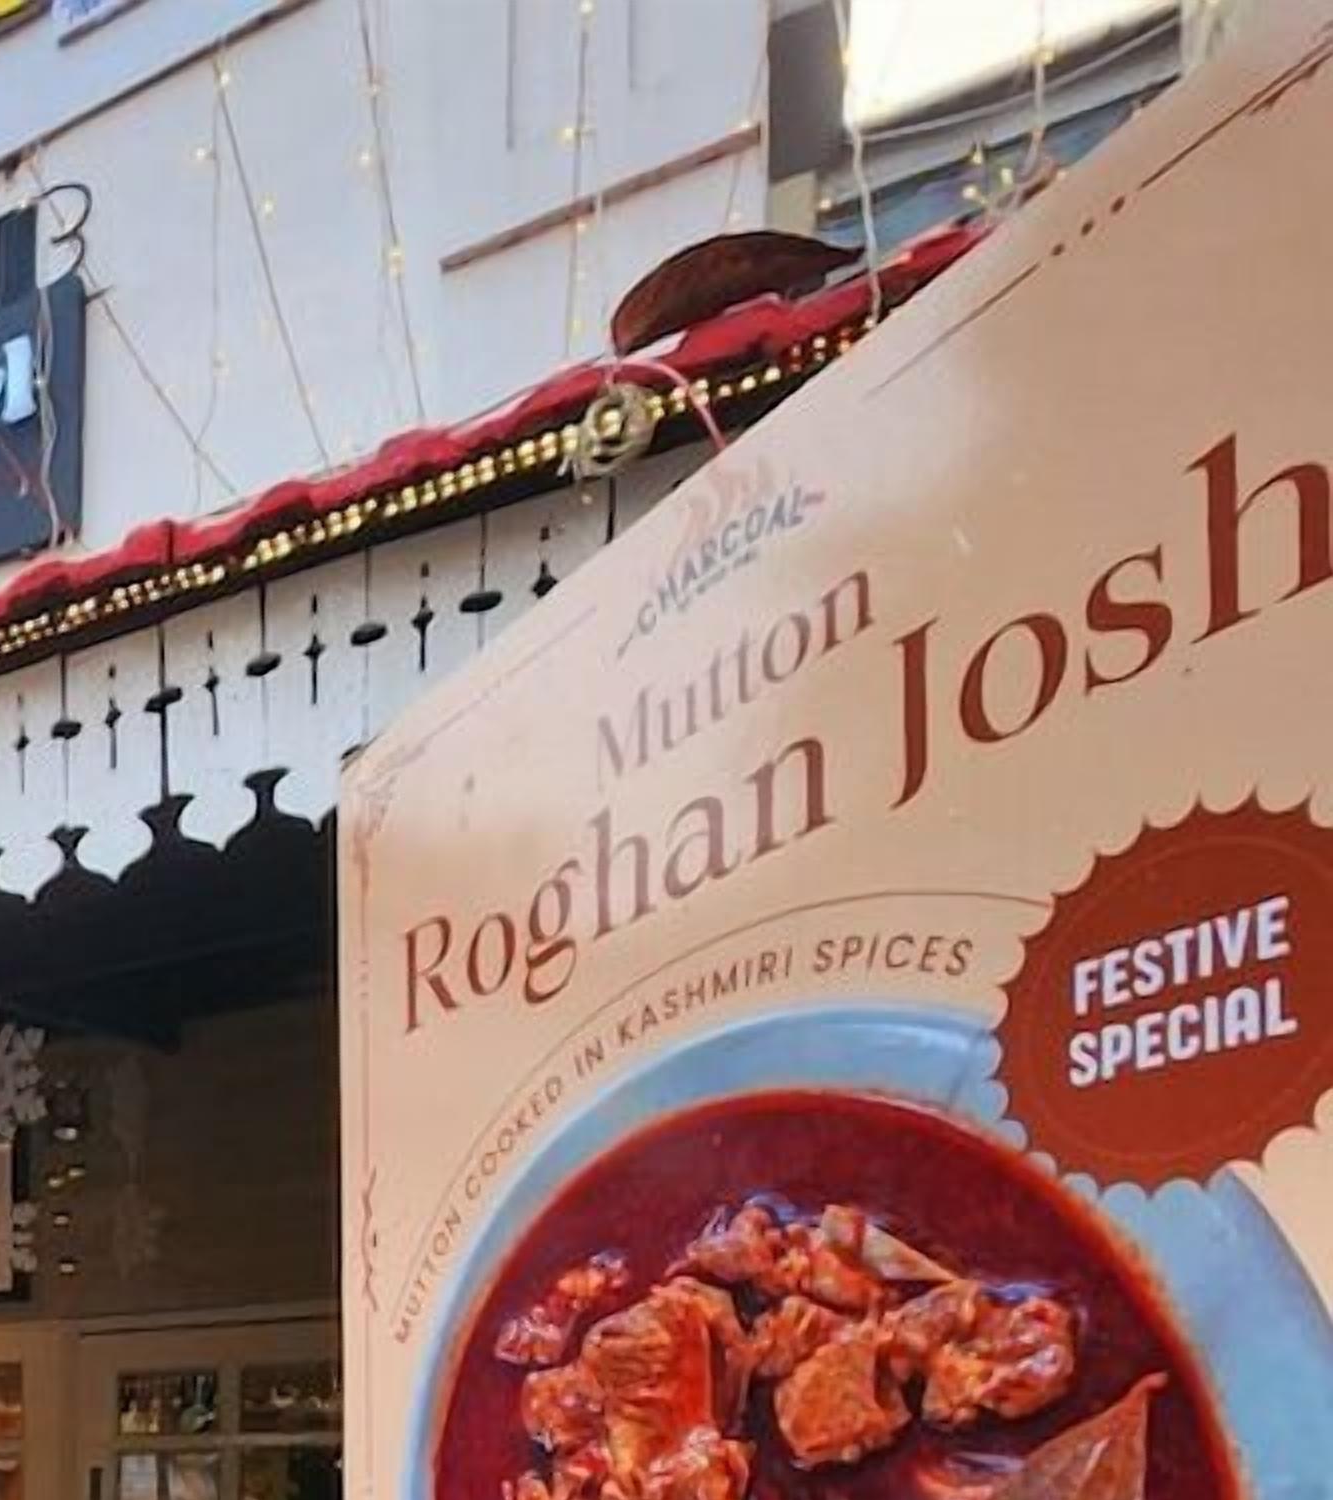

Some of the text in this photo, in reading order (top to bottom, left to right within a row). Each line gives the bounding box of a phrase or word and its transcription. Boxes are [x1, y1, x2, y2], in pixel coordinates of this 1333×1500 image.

[635, 484, 805, 636] CHARCOAL
[400, 432, 1333, 1034] Roghan Josh
[597, 570, 875, 795] Mutton
[1068, 977, 1299, 1088] SPECIAL
[1073, 896, 1291, 1016] FESTIVE
[395, 932, 974, 1344] MUTTON COOKED IN KASHMIRI SPICES
